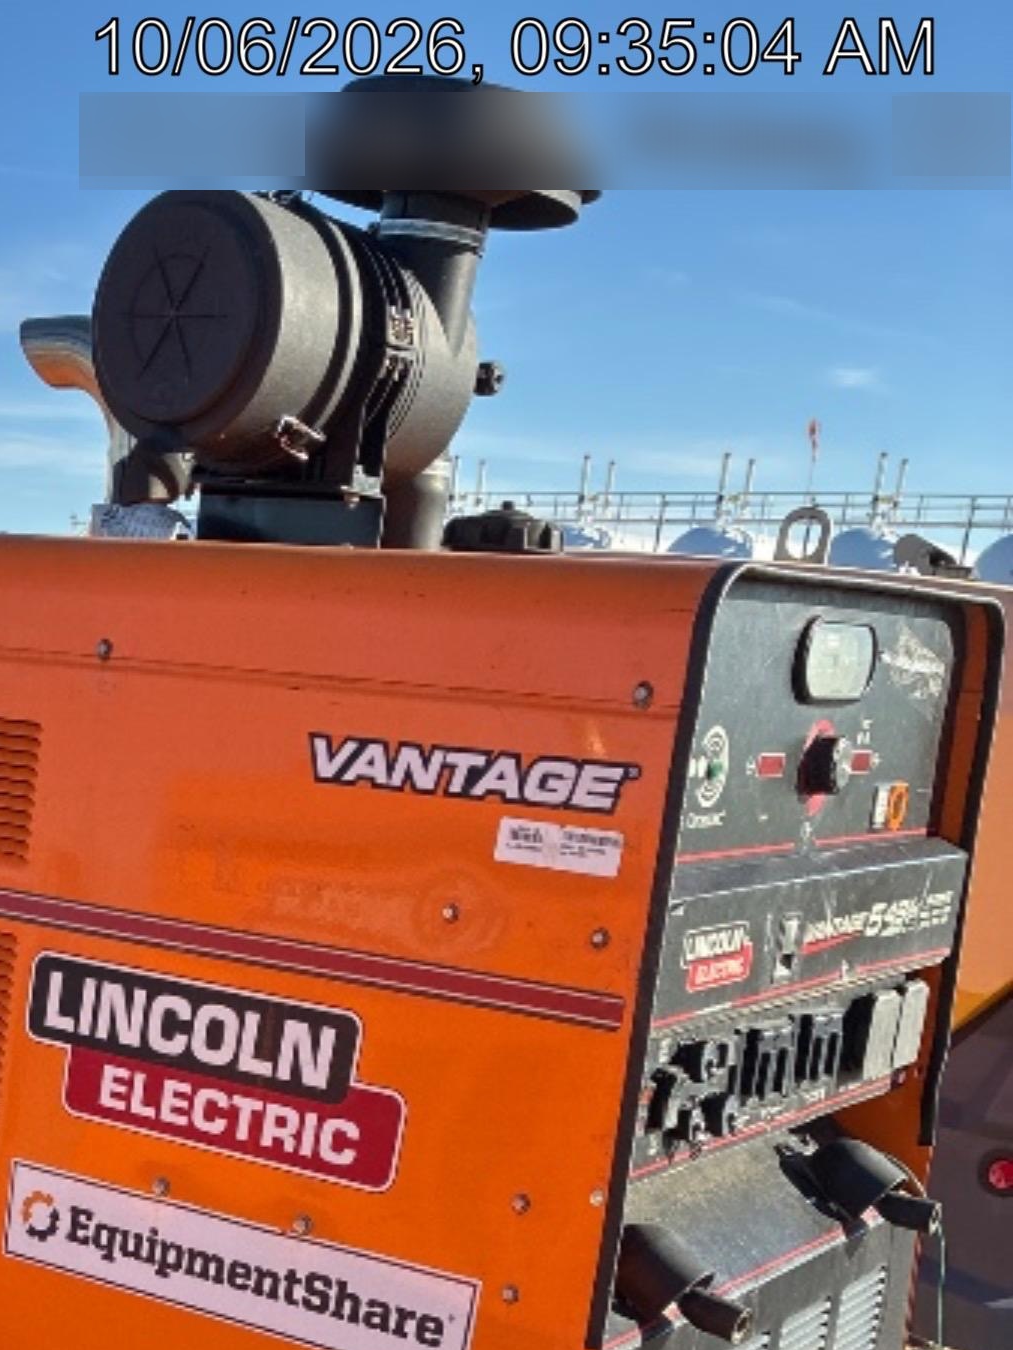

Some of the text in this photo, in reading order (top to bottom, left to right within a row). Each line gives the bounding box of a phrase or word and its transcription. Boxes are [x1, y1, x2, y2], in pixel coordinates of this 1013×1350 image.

[309, 733, 628, 813] VANTAGE
[43, 970, 337, 1090] LINCOLN
[97, 1064, 360, 1167] ELECTRIC
[64, 1205, 444, 1349] EquipmentShare
